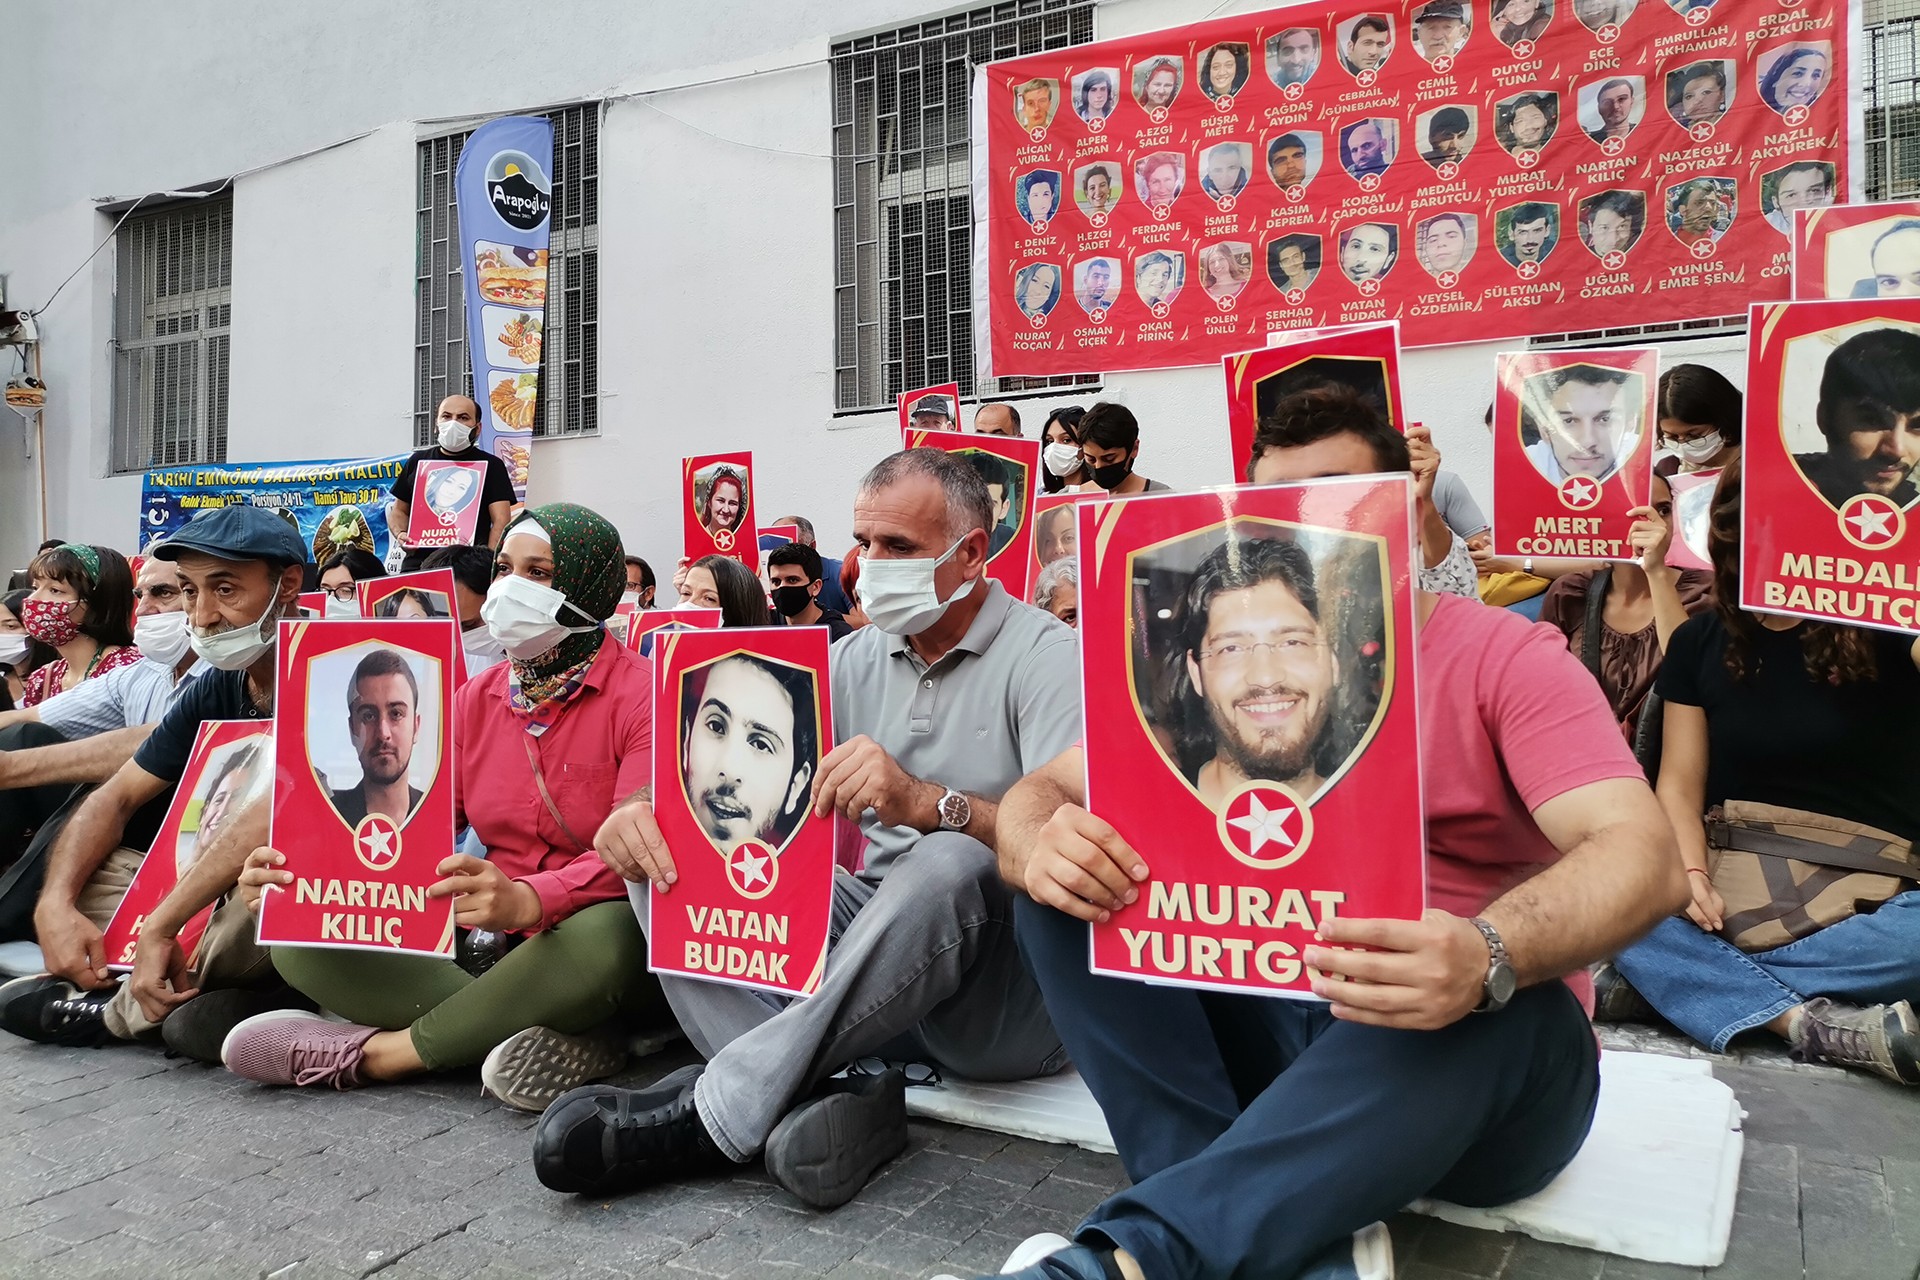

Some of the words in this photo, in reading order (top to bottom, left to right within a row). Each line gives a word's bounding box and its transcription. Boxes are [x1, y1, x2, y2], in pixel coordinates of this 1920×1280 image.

[1758, 7, 1810, 27] ERDAL
[1654, 24, 1729, 48] EMRULLAH
[1745, 17, 1824, 42] BOZKURT
[1589, 46, 1614, 60] ECE
[1654, 36, 1728, 59] AKHAMUR
[1492, 59, 1543, 78] DUYGU
[1583, 57, 1622, 73] DİNÇ
[1417, 75, 1457, 91] CEMİL
[1496, 72, 1538, 88] TUNA
[1338, 87, 1383, 102] CEBRAİL
[1415, 86, 1458, 102] YILDIZ
[1263, 101, 1314, 119] ÇAĞDAŞ
[1325, 97, 1397, 117] GÜNEBAKAN
[1201, 114, 1239, 129] BÜŞRA
[1269, 113, 1308, 127] AYDIN
[1135, 125, 1173, 139] A.EZGİ
[1205, 124, 1234, 138] METE
[1764, 127, 1814, 146] NAZLI
[1076, 135, 1108, 148] ALPER
[1139, 136, 1170, 149] ŞALCI
[1751, 136, 1828, 161] AKYÜREK
[1016, 143, 1052, 157] ALİCAN
[1075, 145, 1109, 158] SAPAN
[1659, 142, 1733, 164] NAZEGÜL
[1018, 154, 1050, 164] VURAL
[1575, 156, 1638, 175] NARTAN
[1665, 156, 1727, 175] BOYRAZ
[1496, 169, 1546, 186] MURAT
[1587, 169, 1626, 185] KILIÇ
[1416, 179, 1467, 197] MEDALİ
[1488, 178, 1555, 198] YURTGÜL
[493, 185, 548, 215] Arapoğlu
[1342, 193, 1386, 208] KORAY
[1410, 192, 1473, 210] BARUTÇU
[1270, 205, 1310, 218] KASIM
[1332, 202, 1396, 219] ÇAPOĞLU
[1204, 214, 1239, 226] İSMET
[1266, 214, 1314, 229] DEPREM
[1077, 230, 1112, 243] H.EZGİ
[1132, 222, 1182, 236] FERDANE
[1204, 224, 1239, 237] ŞEKER
[1014, 240, 1023, 249] E.
[1024, 236, 1057, 248] DENİZ
[1079, 240, 1110, 252] SADET
[1142, 233, 1171, 245] KILIÇ
[1022, 247, 1048, 258] EROL
[1669, 261, 1724, 277] YUNUS
[1585, 272, 1630, 287] UĞUR
[1659, 275, 1699, 290] EMRE
[1704, 271, 1735, 286] ŞEN
[1417, 291, 1465, 304] VEYSEL
[1484, 281, 1561, 299] SÜLEYMAN
[1579, 283, 1635, 299] ÖZKAN
[1341, 299, 1386, 312] VATAN
[1409, 299, 1473, 317] ÖZDEMİR
[1502, 295, 1542, 308] AKSU
[1204, 315, 1238, 325] POLEN
[1265, 307, 1314, 320] SERHAD
[1340, 309, 1386, 323] BUDAK
[1139, 322, 1172, 332] OKAN
[1206, 323, 1236, 335] ÜNLÜ
[1266, 317, 1313, 331] DEVRİM
[1014, 331, 1052, 341] NURAY
[1073, 327, 1113, 338] OSMAN
[1137, 330, 1174, 342] PİRİNÇ
[1013, 341, 1052, 352] KOÇAN
[1078, 336, 1108, 348] ÇİÇEK
[200, 495, 225, 508] Ekmek
[251, 493, 282, 507] Porsiyon
[313, 490, 338, 505] Hamsi
[338, 490, 357, 504] Tava
[358, 489, 369, 503] 30
[422, 528, 461, 538] NURAY
[1534, 516, 1602, 535] MERT
[1516, 533, 1623, 556] CÖMERT
[1764, 581, 1920, 629] BARUTÇ
[295, 877, 425, 912] NARTAN
[1147, 880, 1346, 930] MURAT
[321, 913, 402, 948] KILIÇ
[685, 904, 789, 945] VATAN
[684, 940, 790, 984] BUDAK
[1118, 928, 1366, 984] YURTG
